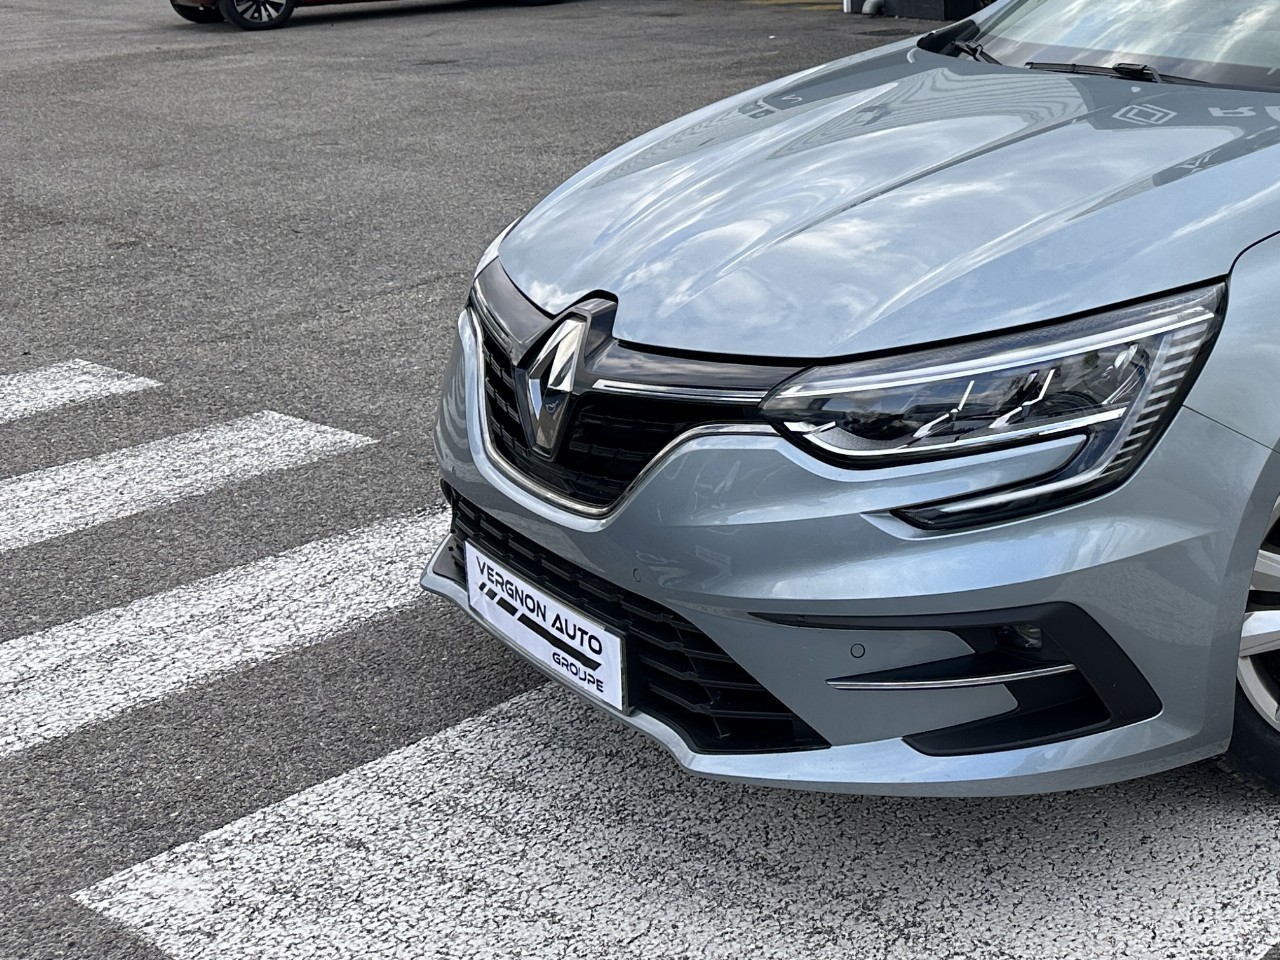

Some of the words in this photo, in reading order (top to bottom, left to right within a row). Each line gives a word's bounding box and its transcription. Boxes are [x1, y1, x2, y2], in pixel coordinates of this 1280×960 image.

[475, 555, 547, 622] VERGNON
[551, 613, 603, 656] AUTO
[552, 651, 604, 694] GROUPE
